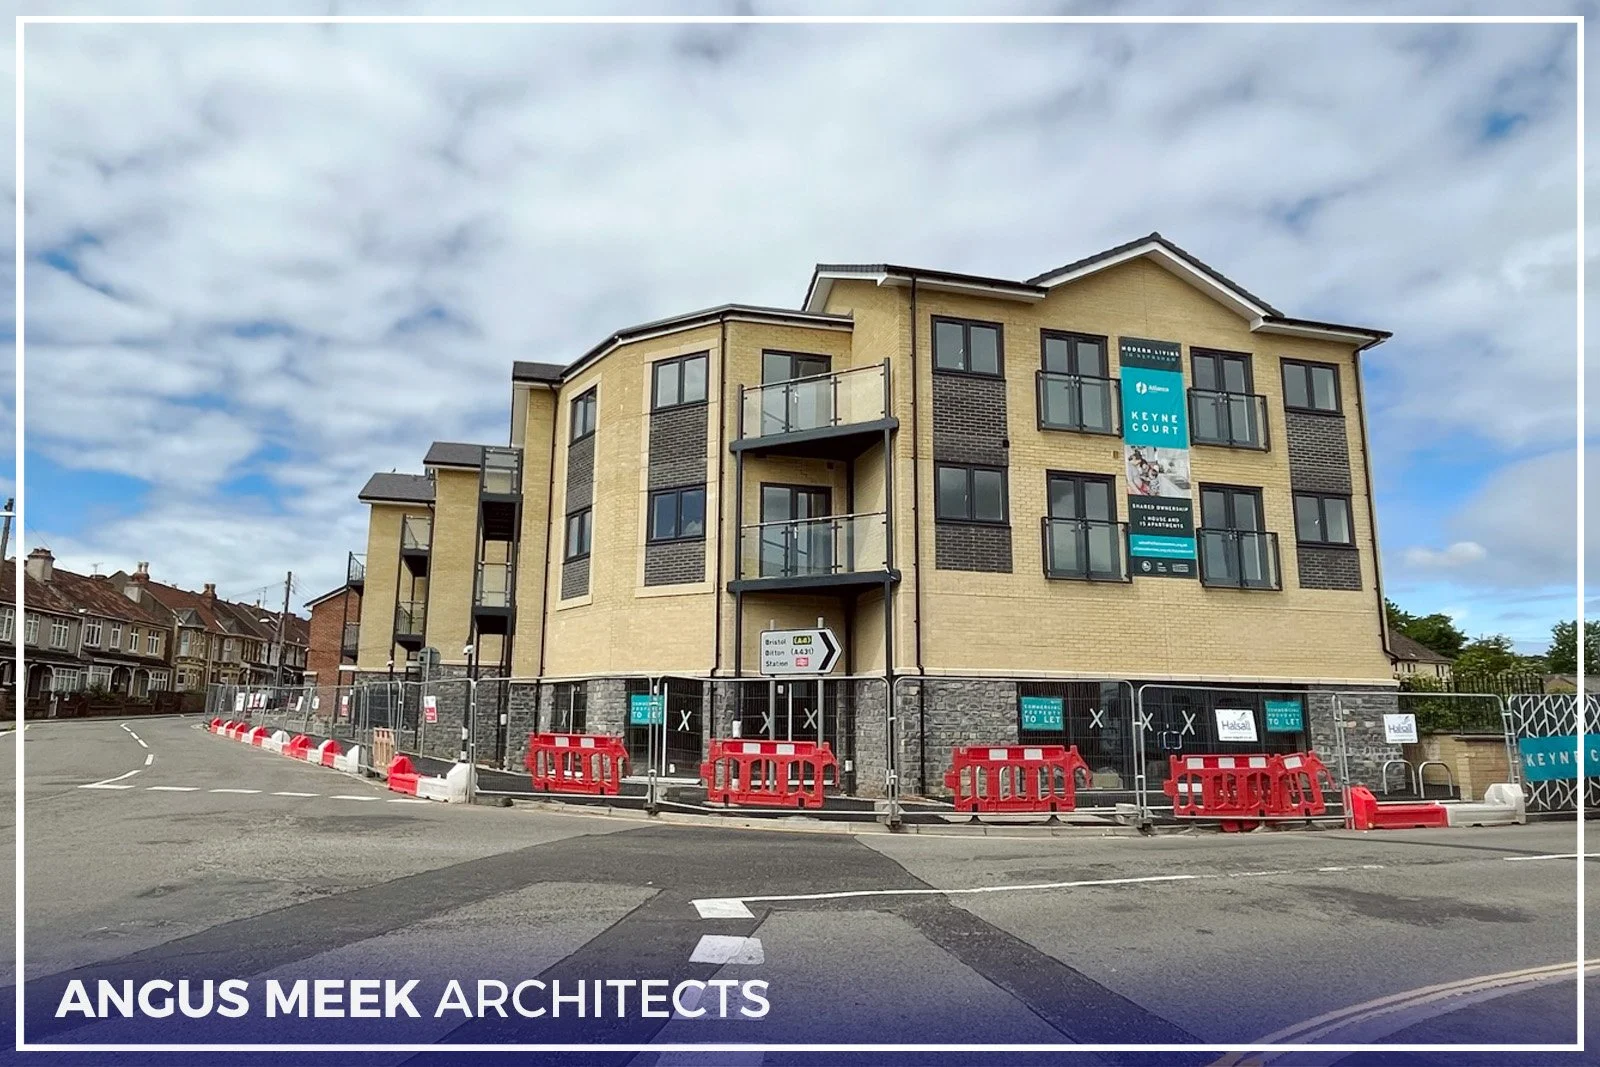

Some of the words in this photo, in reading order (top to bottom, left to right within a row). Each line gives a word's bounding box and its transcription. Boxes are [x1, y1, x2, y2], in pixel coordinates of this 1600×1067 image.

[1131, 411, 1178, 423] KEYNE
[1132, 423, 1178, 434] COURT
[1024, 715, 1037, 723] TO
[1044, 716, 1061, 724] LET
[1268, 718, 1279, 726] TO
[1285, 718, 1300, 726] LET
[1221, 720, 1252, 731] Halsall
